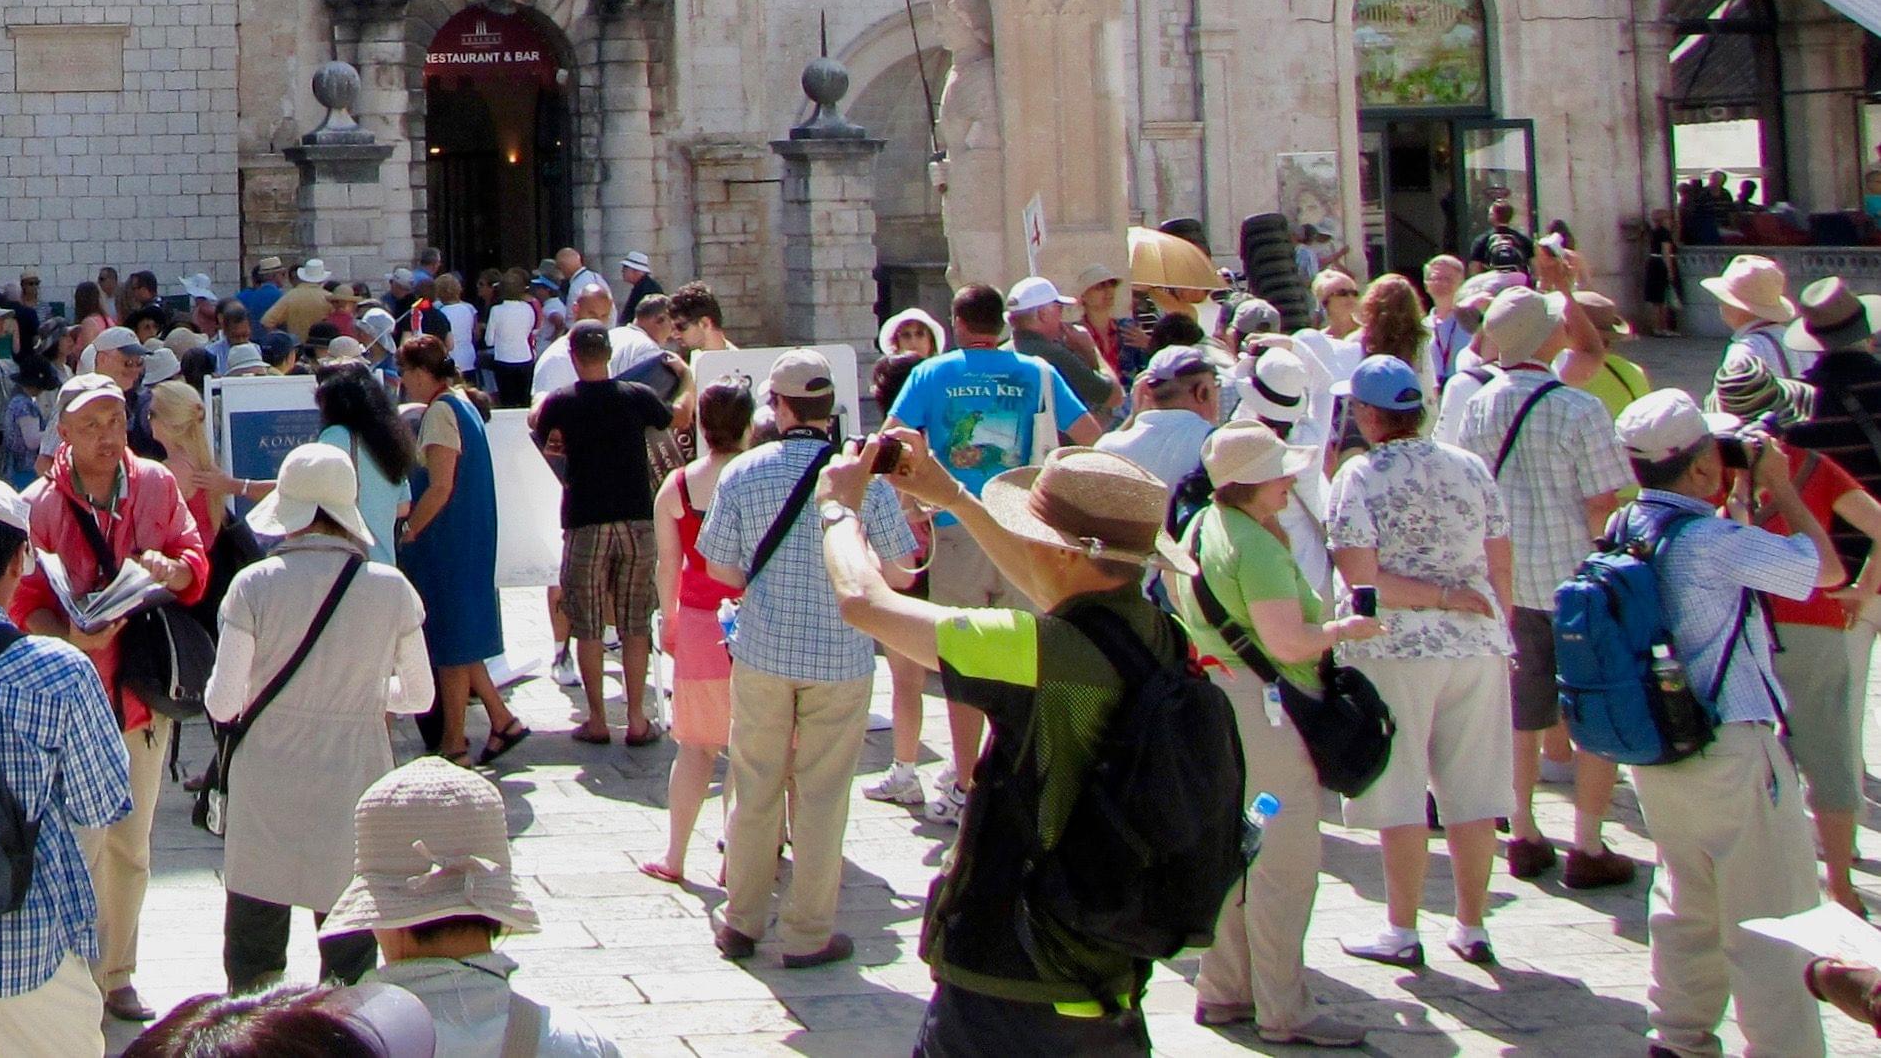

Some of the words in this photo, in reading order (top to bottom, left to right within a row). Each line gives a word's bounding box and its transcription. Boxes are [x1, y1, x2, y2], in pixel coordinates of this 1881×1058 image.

[425, 51, 500, 64] RESTAURANT
[503, 52, 513, 62] &
[515, 51, 540, 62] BAR
[945, 385, 991, 399] SIESTA
[996, 383, 1025, 398] KEY
[258, 433, 319, 448] KONCE
